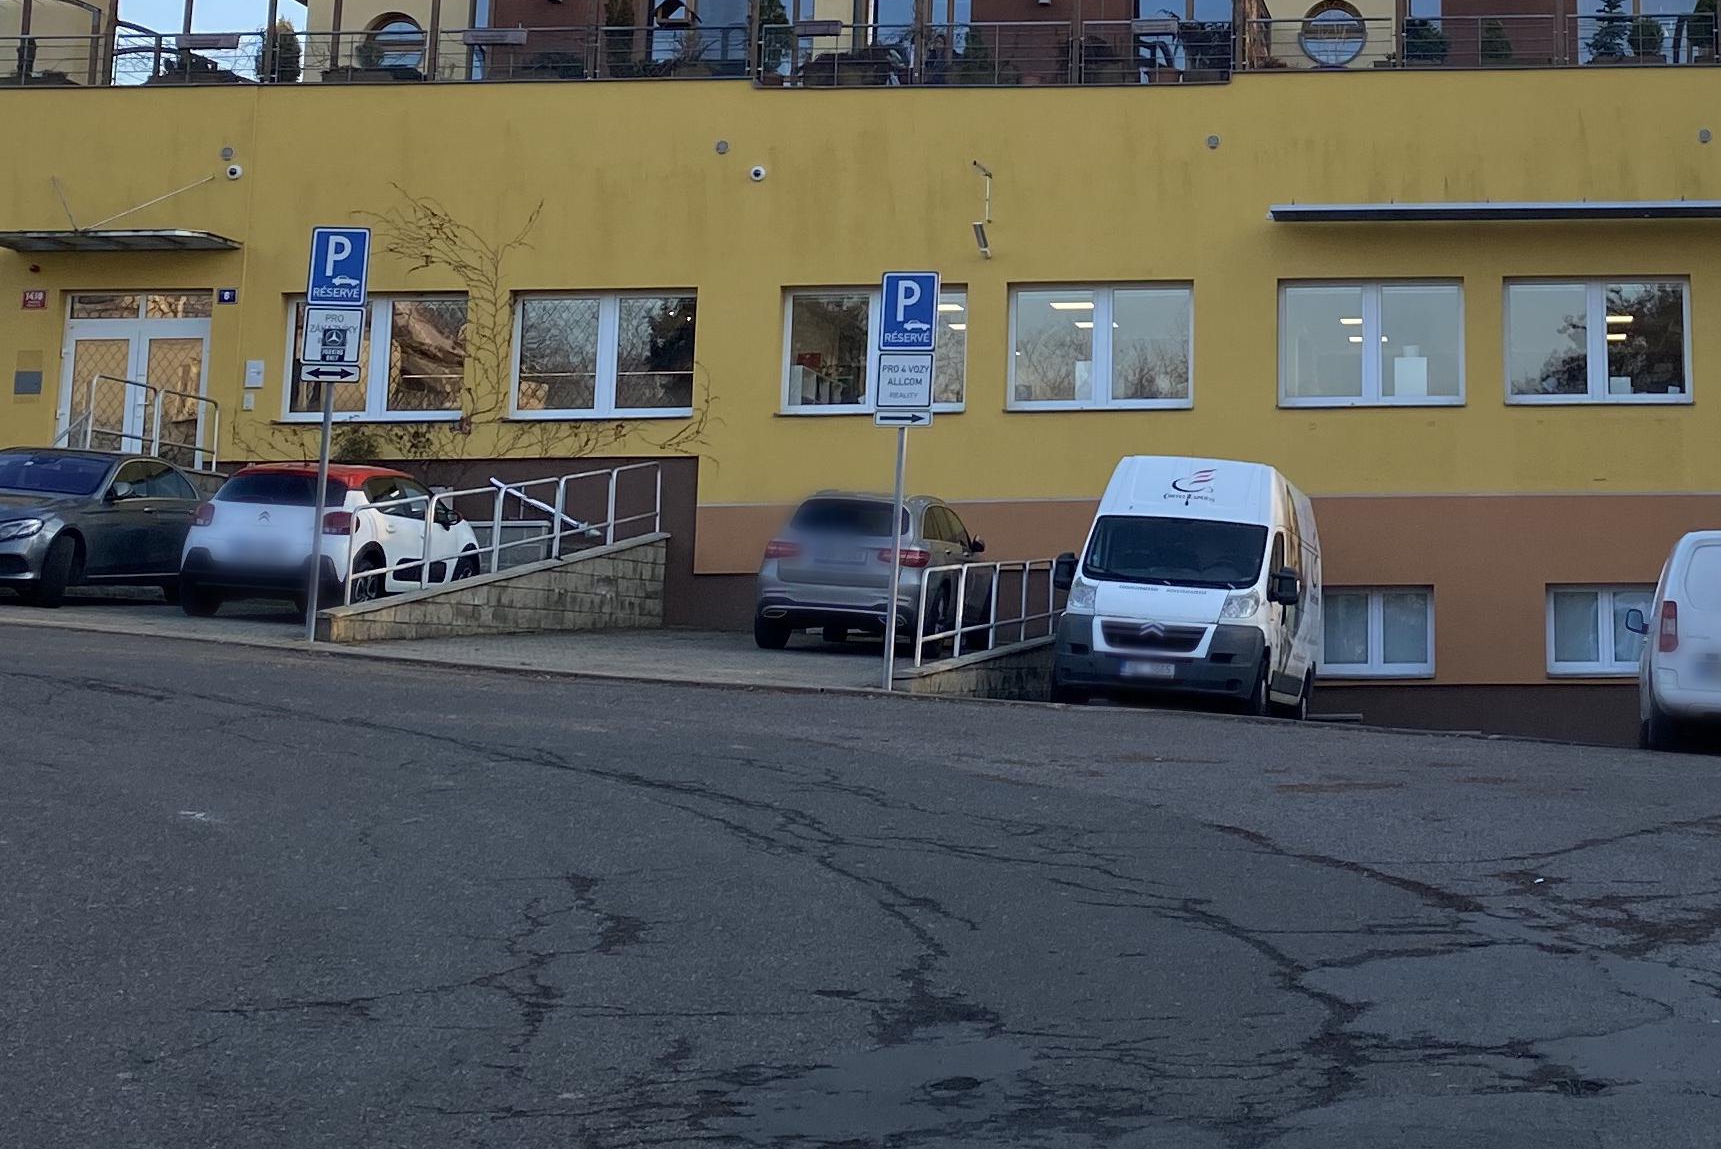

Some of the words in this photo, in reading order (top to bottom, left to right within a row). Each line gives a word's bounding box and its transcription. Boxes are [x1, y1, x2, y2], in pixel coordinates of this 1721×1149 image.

[325, 234, 353, 277] P
[312, 285, 360, 299] RÉSERVÉ
[896, 279, 922, 322] P
[324, 313, 345, 323] PRO
[884, 331, 930, 343] RÉSERVÉ
[882, 364, 900, 373] PRO
[901, 364, 906, 373] 4
[908, 364, 930, 374] VOZY
[887, 377, 923, 386] ALLCOM
[889, 391, 919, 399] REALITY
